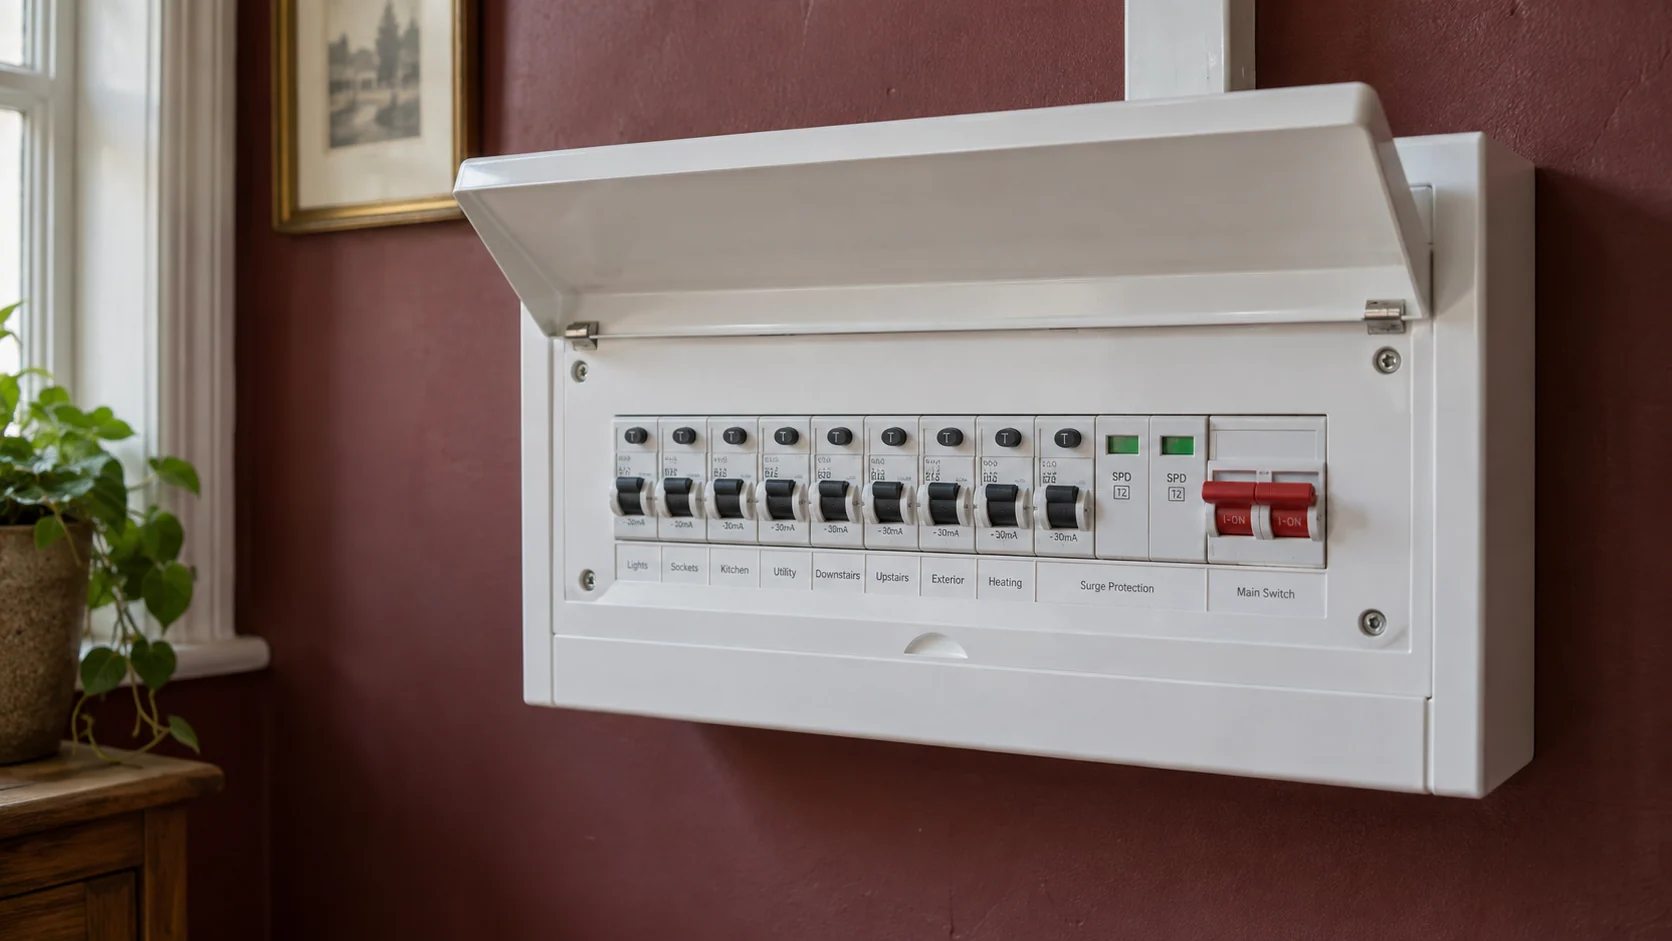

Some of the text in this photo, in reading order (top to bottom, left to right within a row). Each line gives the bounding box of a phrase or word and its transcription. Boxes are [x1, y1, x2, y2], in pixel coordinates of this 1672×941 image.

[1112, 472, 1132, 482] SPD
[1166, 473, 1187, 483] SPD
[627, 560, 648, 572] Lights
[670, 562, 699, 573] Sockets
[720, 564, 749, 575] Kitchen
[773, 567, 797, 580] Utility
[815, 569, 861, 581] Downstairs
[875, 571, 909, 584] Upstairs
[931, 573, 965, 585] Exterior
[988, 576, 1023, 590] Heating
[1080, 580, 1155, 594] Surge Protection
[1236, 587, 1295, 600] Main Switch
